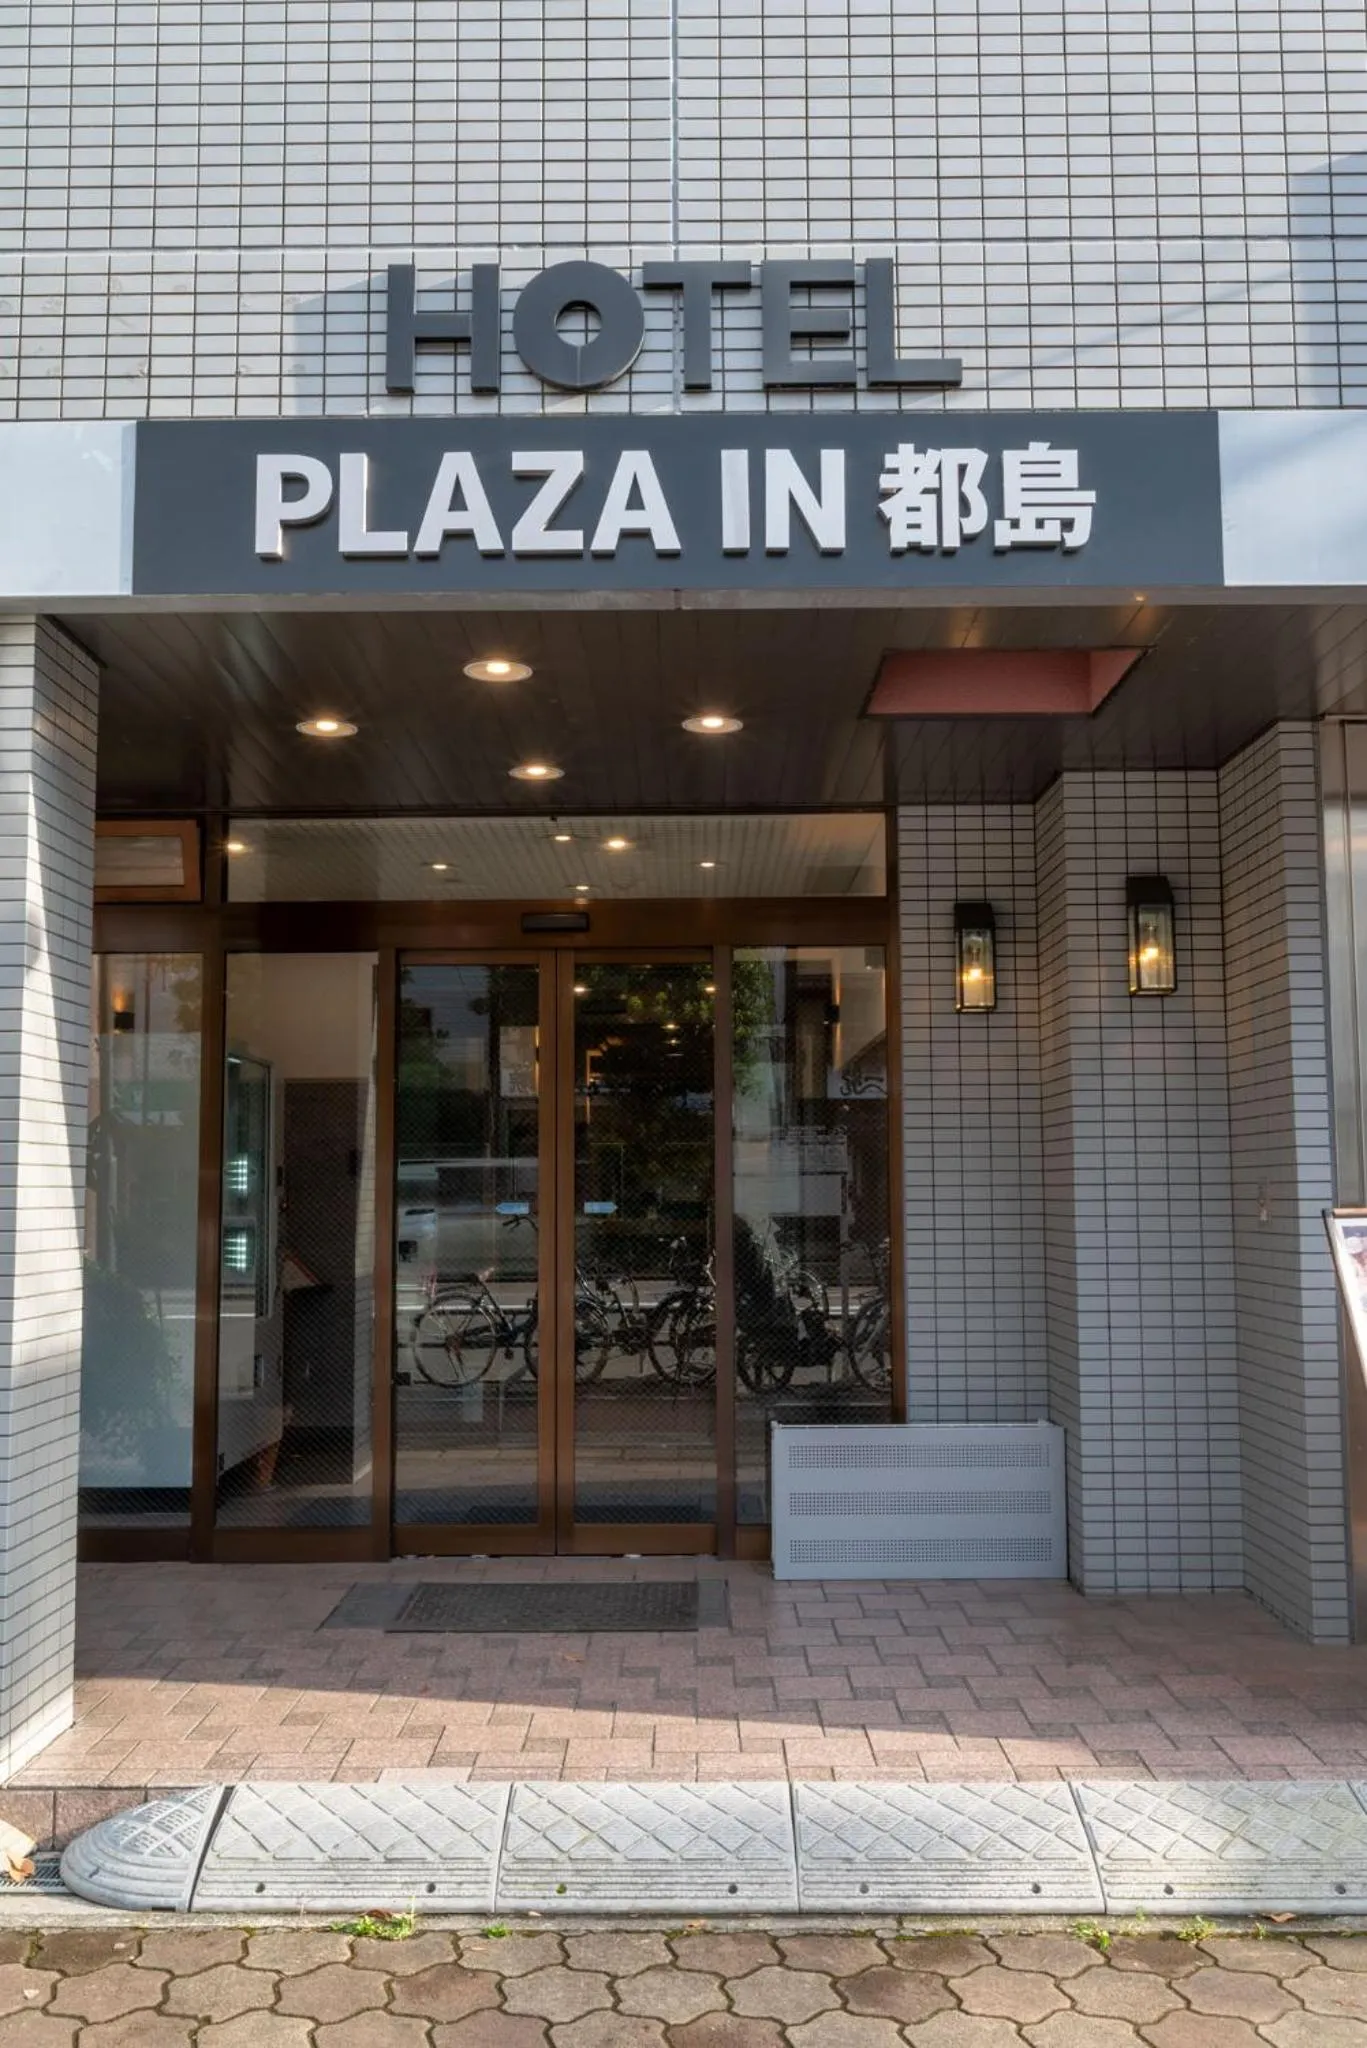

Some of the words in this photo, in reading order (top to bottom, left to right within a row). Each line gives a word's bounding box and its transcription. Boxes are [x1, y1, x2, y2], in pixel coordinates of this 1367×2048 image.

[385, 258, 963, 394] HOTEL
[255, 450, 682, 557] PLAZA
[720, 448, 846, 554] IN
[877, 441, 1097, 554] 都島
